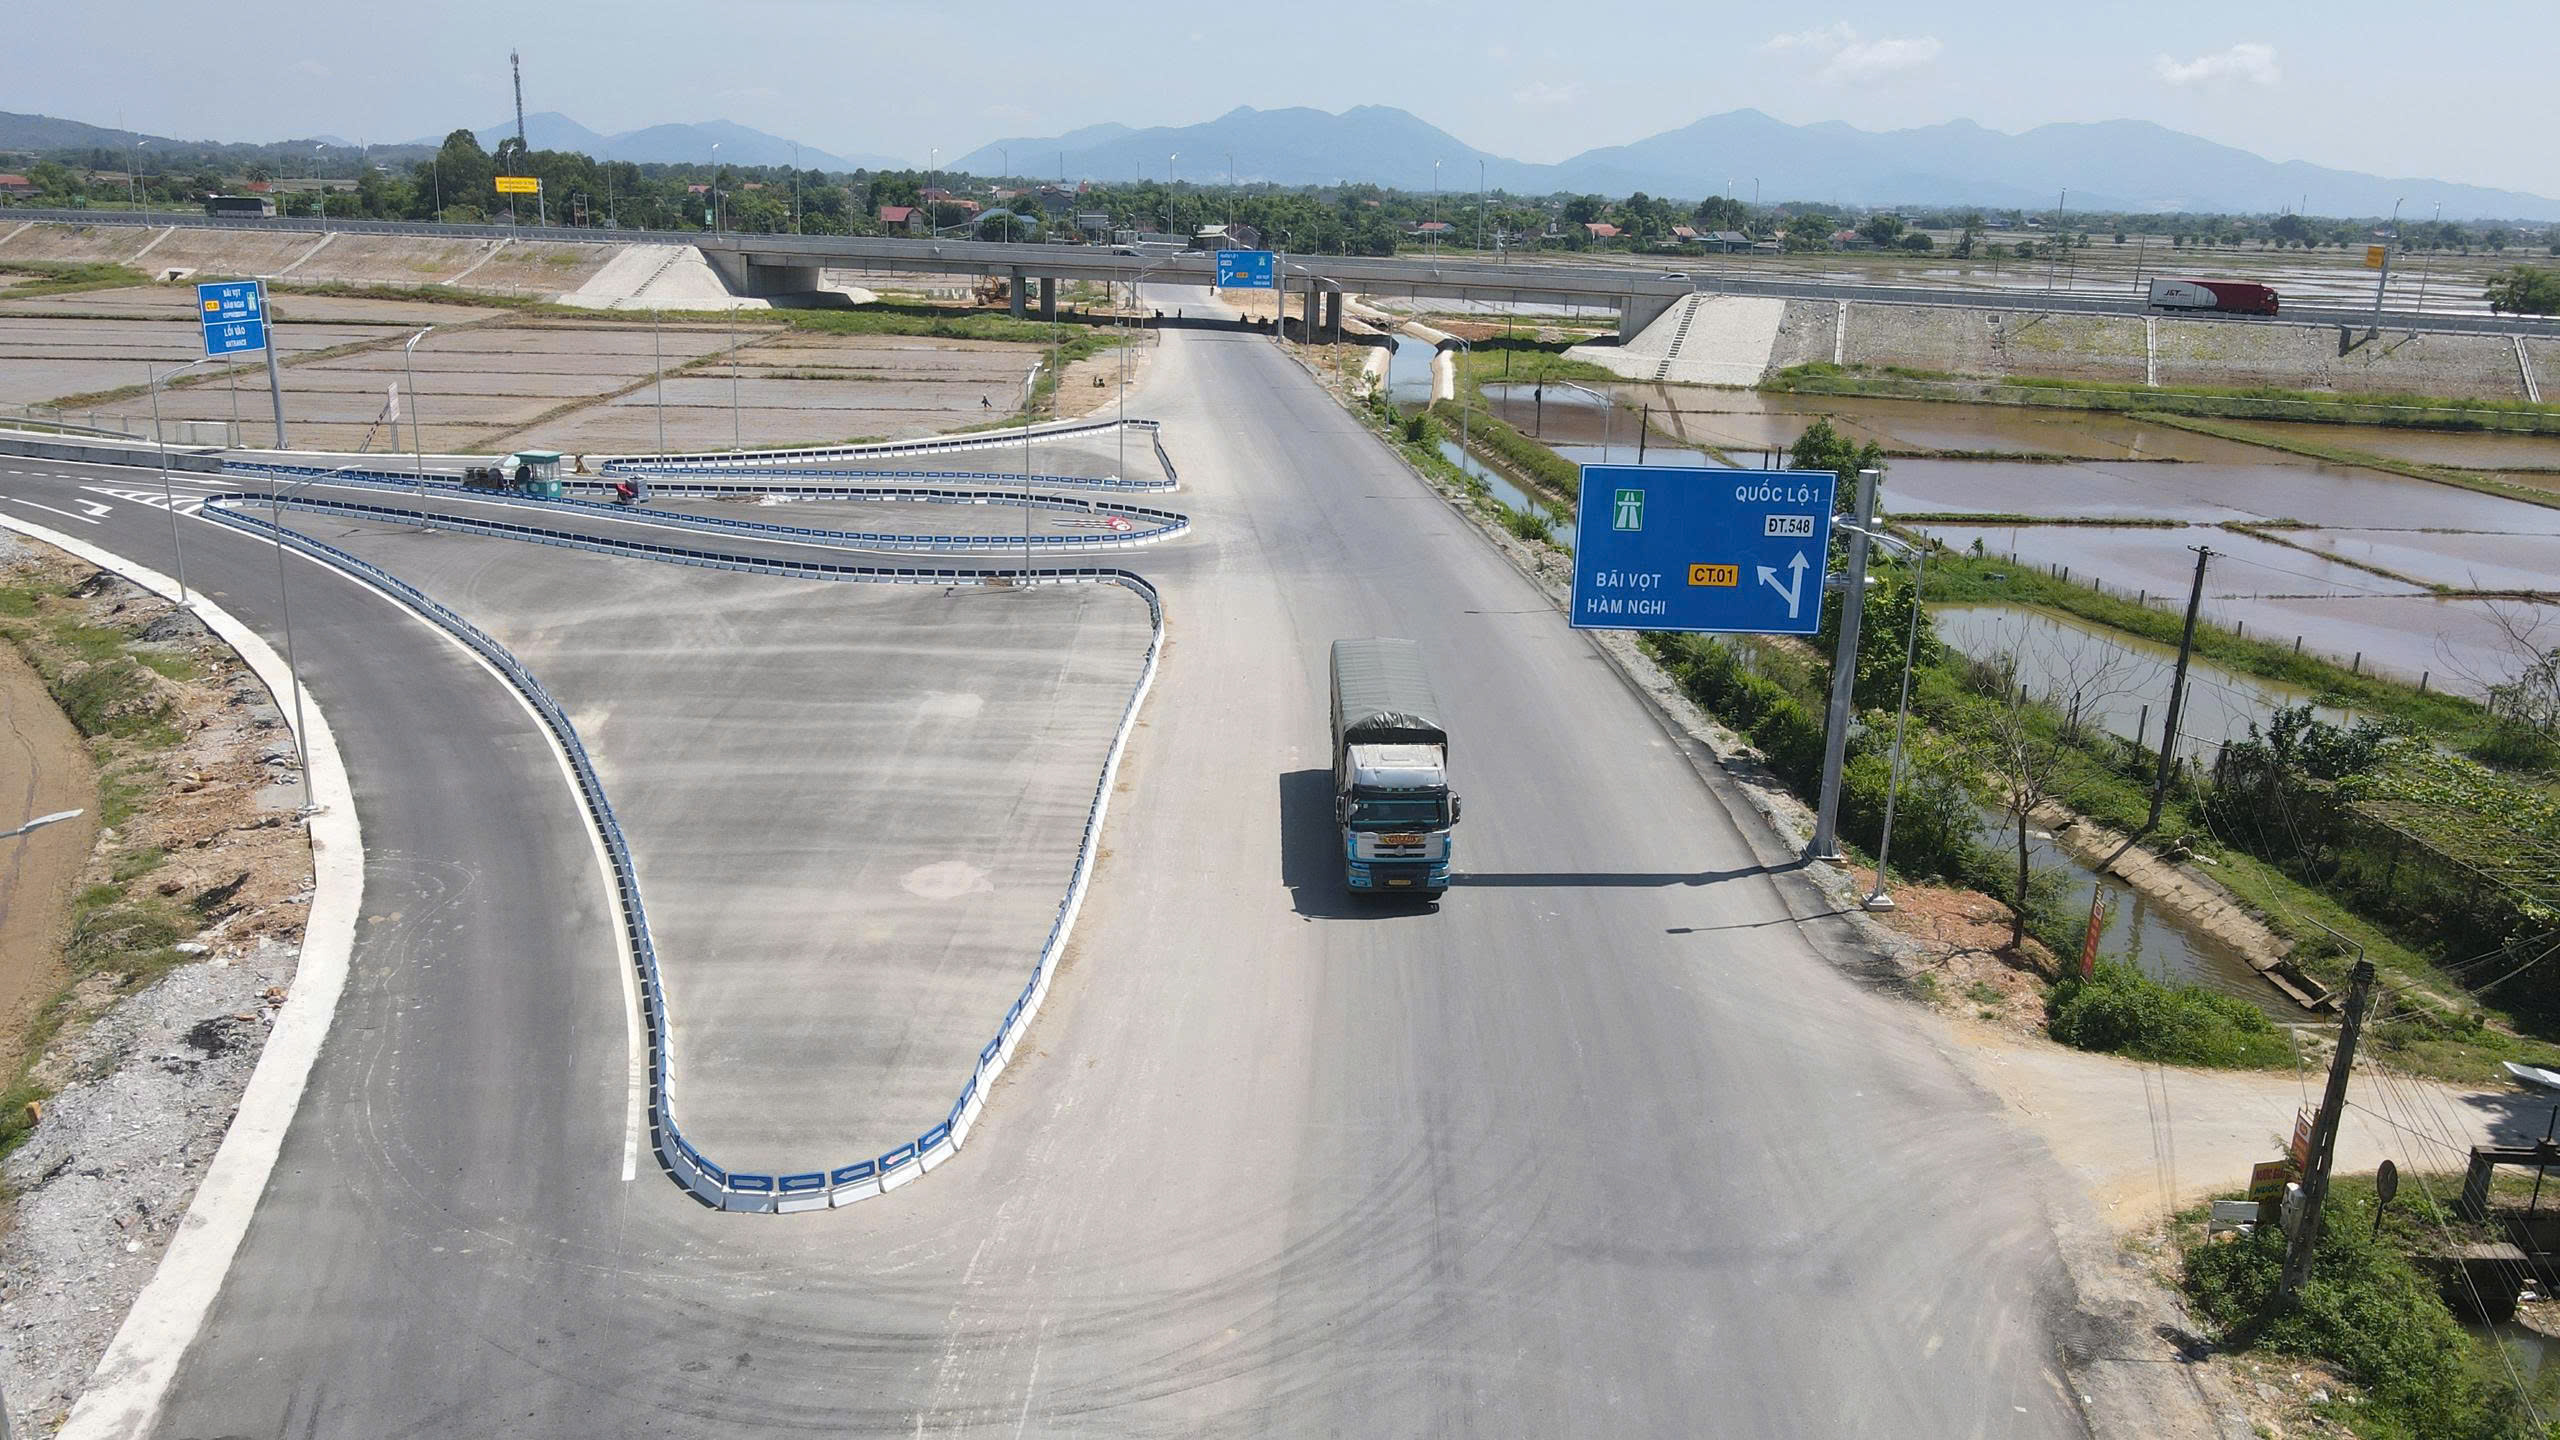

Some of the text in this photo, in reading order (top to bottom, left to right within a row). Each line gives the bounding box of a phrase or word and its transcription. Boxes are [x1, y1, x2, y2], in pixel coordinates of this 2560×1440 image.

[1735, 478, 1819, 506] QUỐC LỘ 1
[1768, 518, 1810, 534] ĐT.548
[1596, 569, 1662, 592] BÃI VỌT
[1694, 568, 1733, 583] CT.01
[1587, 594, 1666, 616] HÀM NGHI
